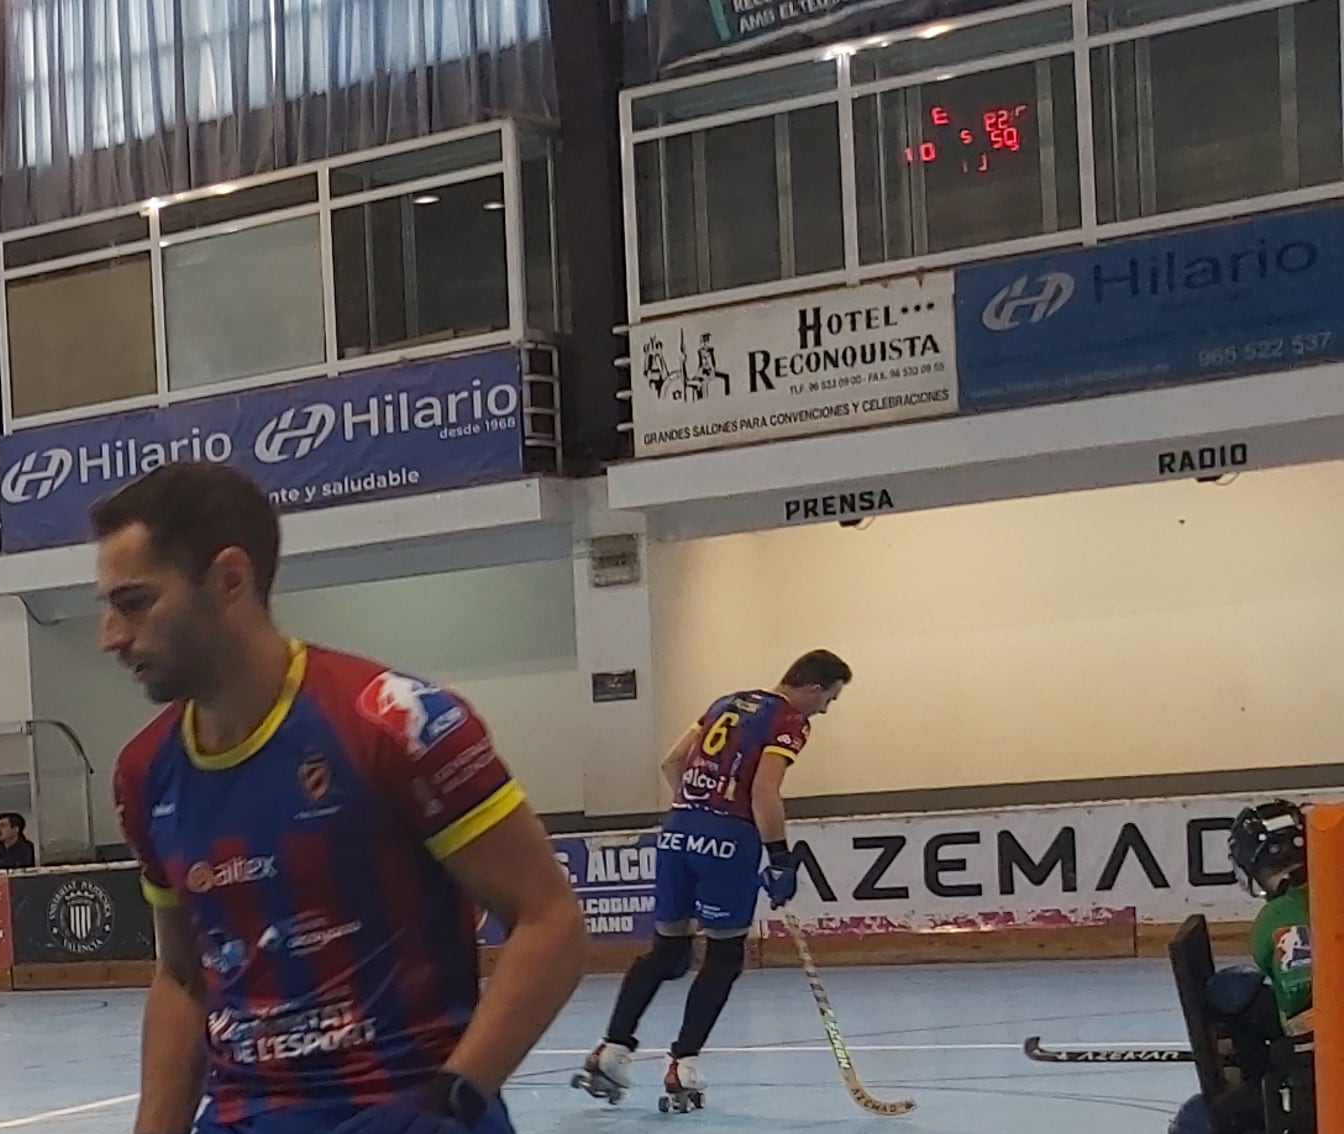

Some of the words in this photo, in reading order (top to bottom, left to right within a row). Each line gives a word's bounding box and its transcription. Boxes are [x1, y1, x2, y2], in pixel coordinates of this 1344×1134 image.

[1093, 238, 1318, 301] Hilario
[798, 306, 898, 349] HOTEL
[748, 334, 940, 393] RECONQUISTA
[342, 377, 519, 442] Hilario
[439, 423, 478, 440] desde
[643, 427, 691, 446] GRANDES
[692, 421, 739, 438] SALONES
[739, 415, 768, 430] PARA
[769, 403, 851, 427] CONVENCIONES
[852, 401, 861, 414] Y
[862, 388, 950, 414] CELEBRACIONES
[77, 428, 234, 484] Hilario
[1158, 442, 1248, 475] RADIO
[267, 487, 300, 504] nte
[304, 486, 317, 503] y
[321, 467, 421, 496] saludable
[784, 489, 894, 521] PRENSA
[702, 711, 740, 756] 6
[681, 767, 726, 793] Alcoi
[587, 846, 657, 884] ALCO
[788, 815, 1238, 902] AZEMAD
